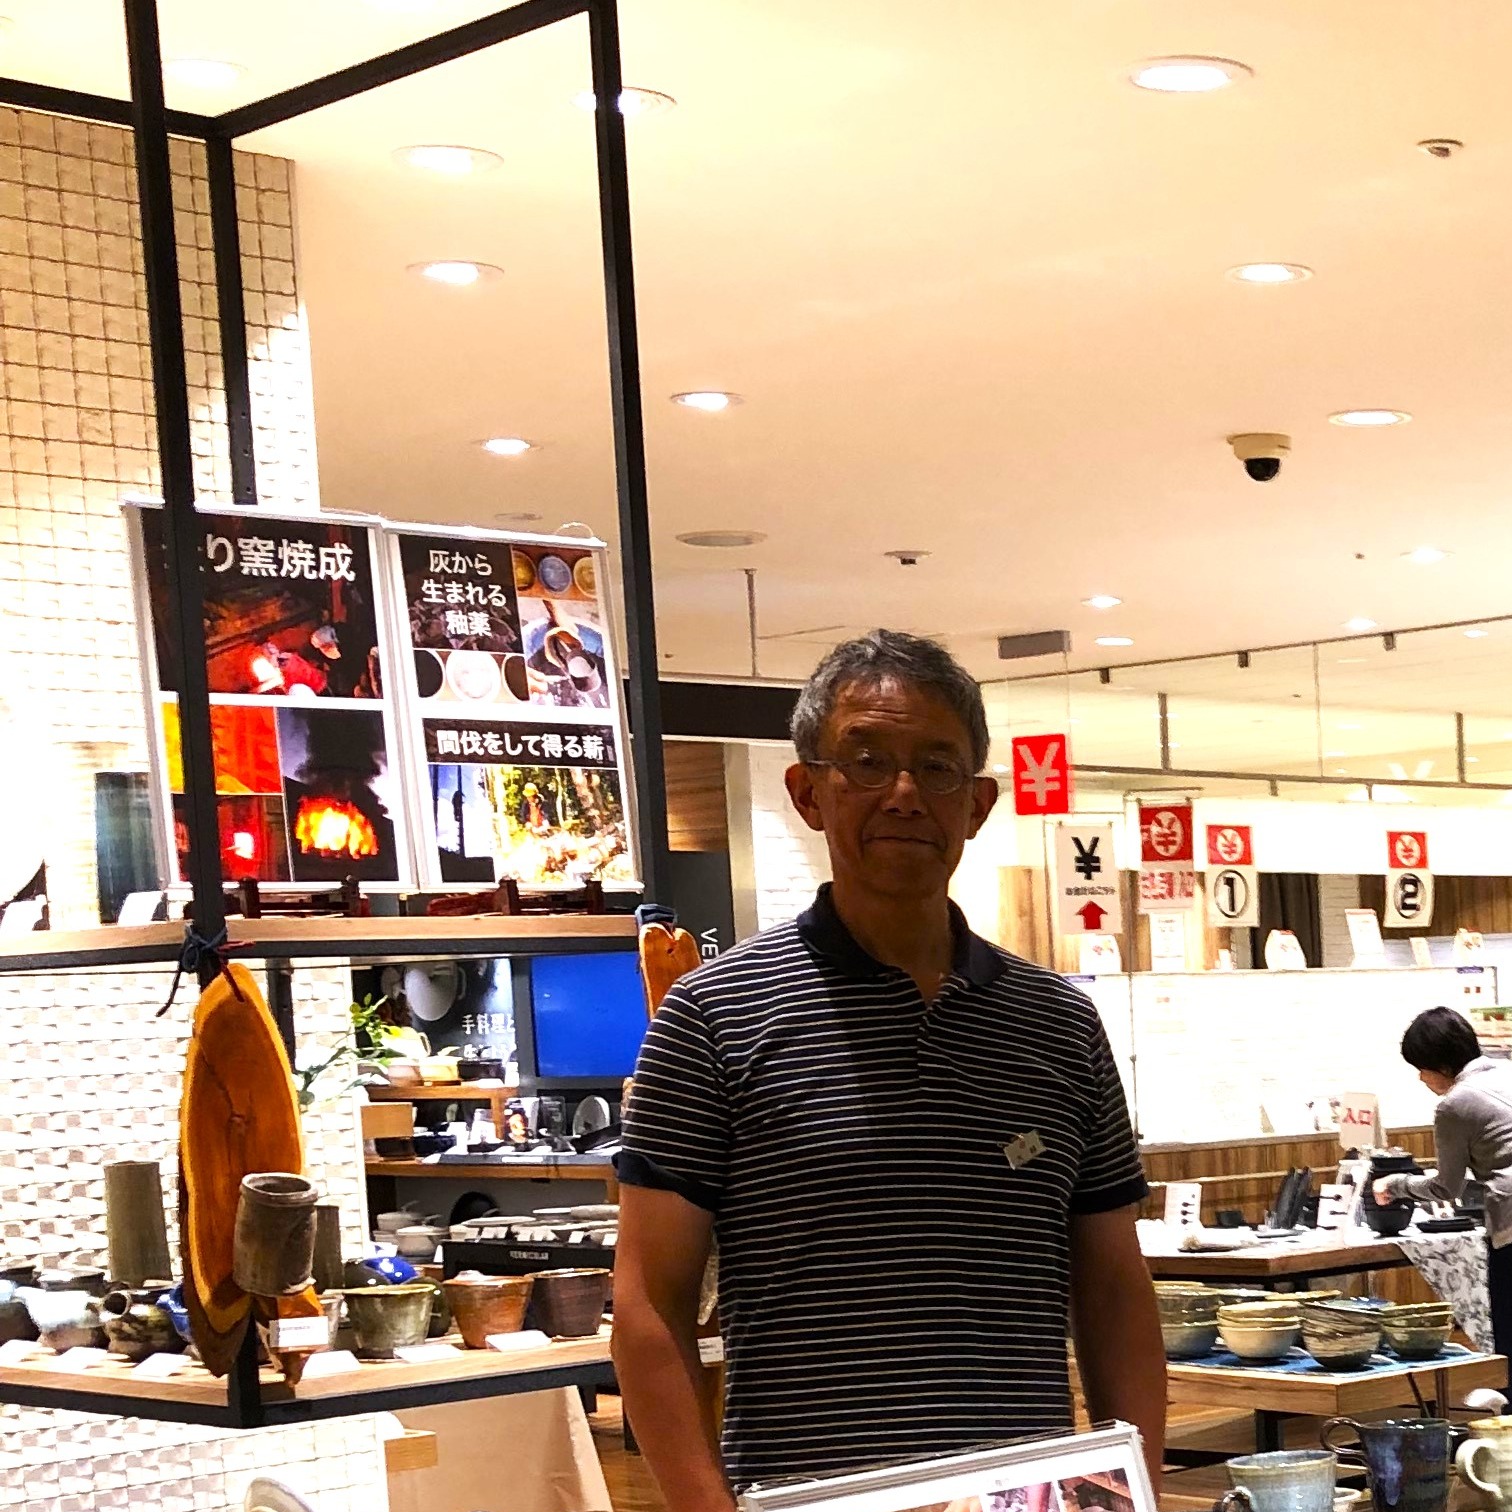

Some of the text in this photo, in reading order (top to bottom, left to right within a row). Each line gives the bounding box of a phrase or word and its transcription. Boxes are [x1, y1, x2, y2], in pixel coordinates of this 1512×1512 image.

[198, 533, 356, 582] り窯焼成
[429, 549, 493, 576] 灰から
[421, 578, 507, 607] 生まれる
[445, 611, 493, 637] 釉薬
[436, 730, 604, 762] 間伐をして得る薪
[701, 927, 720, 963] VE
[1341, 1107, 1373, 1126] 入口
